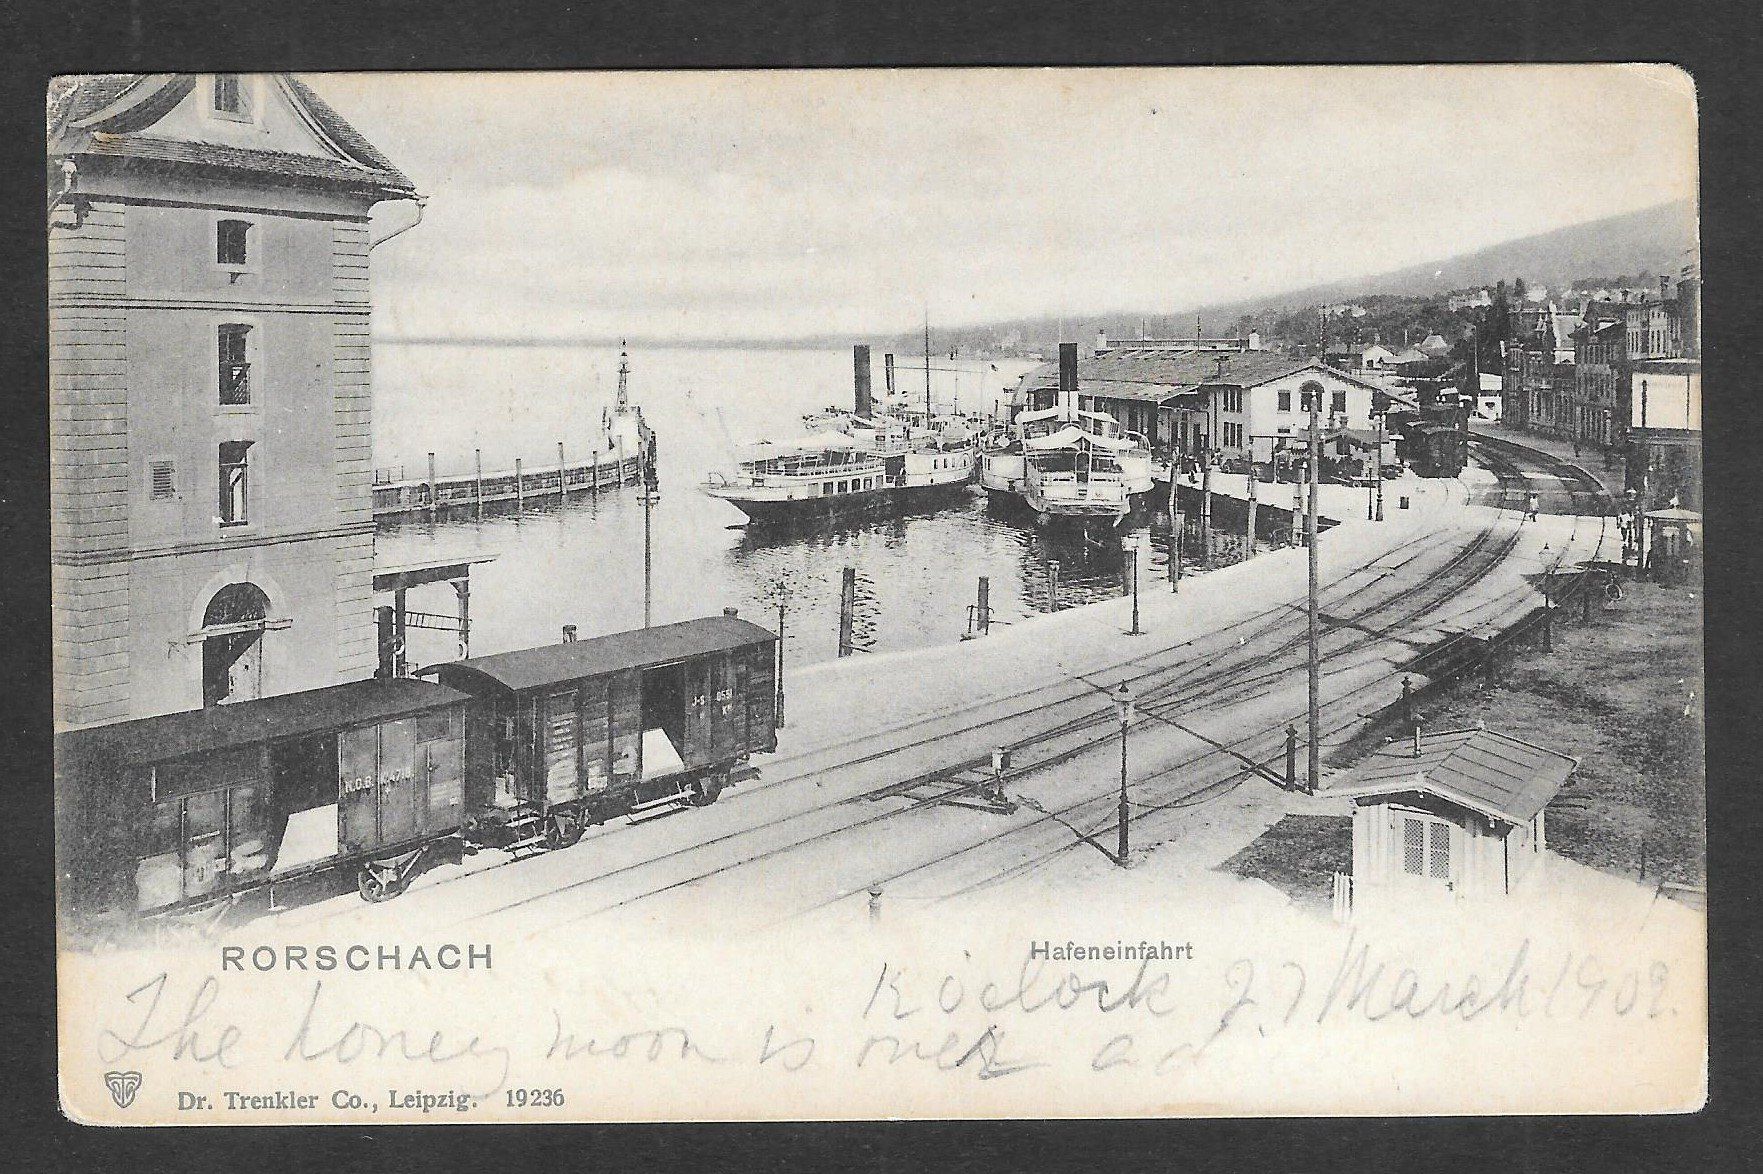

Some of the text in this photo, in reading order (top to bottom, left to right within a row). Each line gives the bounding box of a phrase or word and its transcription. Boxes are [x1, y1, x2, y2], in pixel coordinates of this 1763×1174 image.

[222, 944, 492, 971] RORSCHACH
[1031, 940, 1193, 961] Hafeneinfahrt
[1316, 926, 1534, 1022] March
[97, 973, 243, 1064] The
[545, 1009, 730, 1061] moon
[760, 1006, 815, 1071] is
[177, 1088, 565, 1113] Dr. Trenkler Co., Leipzig. 19236
